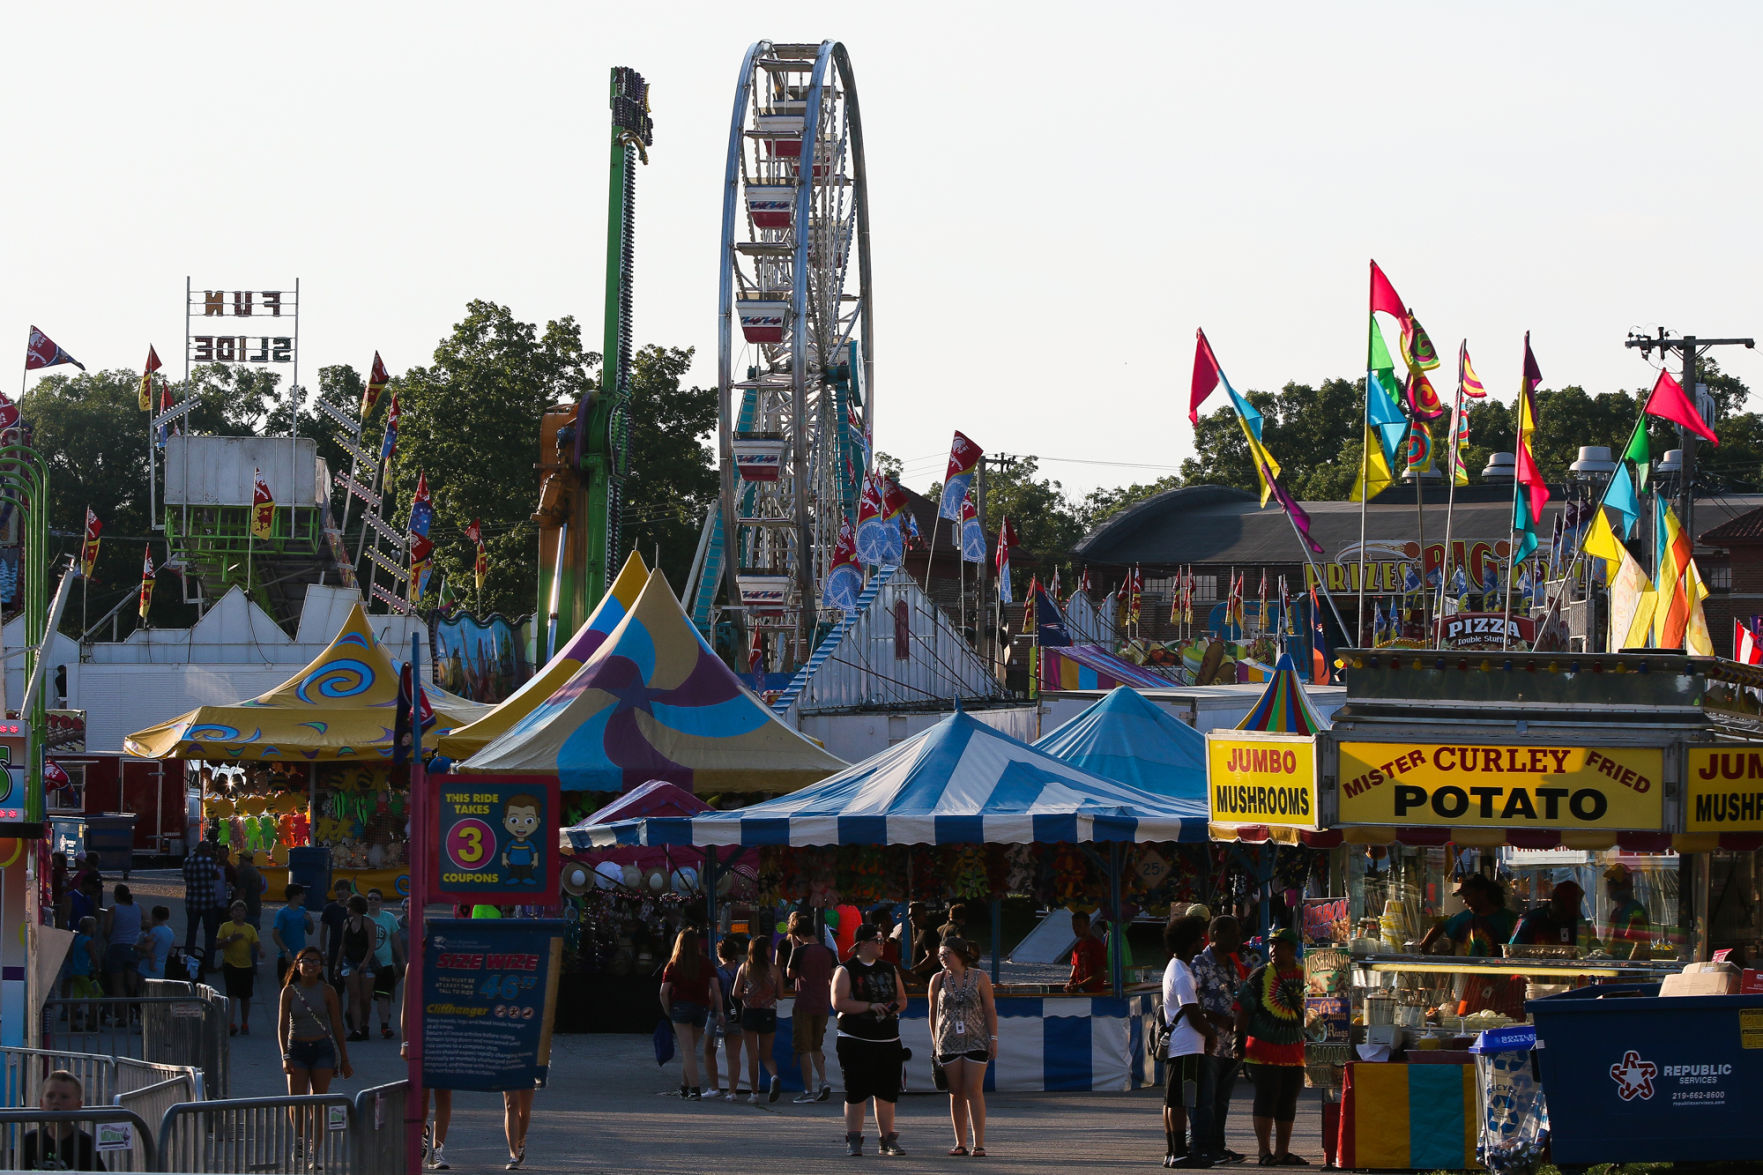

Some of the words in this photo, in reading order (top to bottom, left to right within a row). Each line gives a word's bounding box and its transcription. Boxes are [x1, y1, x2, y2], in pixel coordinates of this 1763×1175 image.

[1448, 617, 1521, 639] PIZZA
[1484, 635, 1511, 646] Stuffd
[1227, 748, 1296, 774] JUMBO
[1342, 750, 1426, 799] MISTER
[1433, 746, 1571, 774] CURLEY
[1585, 750, 1651, 794] FRIED
[445, 793, 470, 803] THIS
[473, 793, 499, 803] RIDE
[1216, 785, 1309, 816] MUSHROOMS
[1394, 785, 1608, 821] POTATO
[454, 804, 490, 815] TAKES
[458, 826, 484, 863] 3
[442, 873, 499, 884] COUPONS
[436, 952, 485, 970] SIZE
[485, 953, 540, 972] WIZE
[426, 1003, 490, 1018] Cliffhanger
[1663, 1063, 1733, 1077] REPUBLIC
[1678, 1076, 1719, 1085] SERVICES
